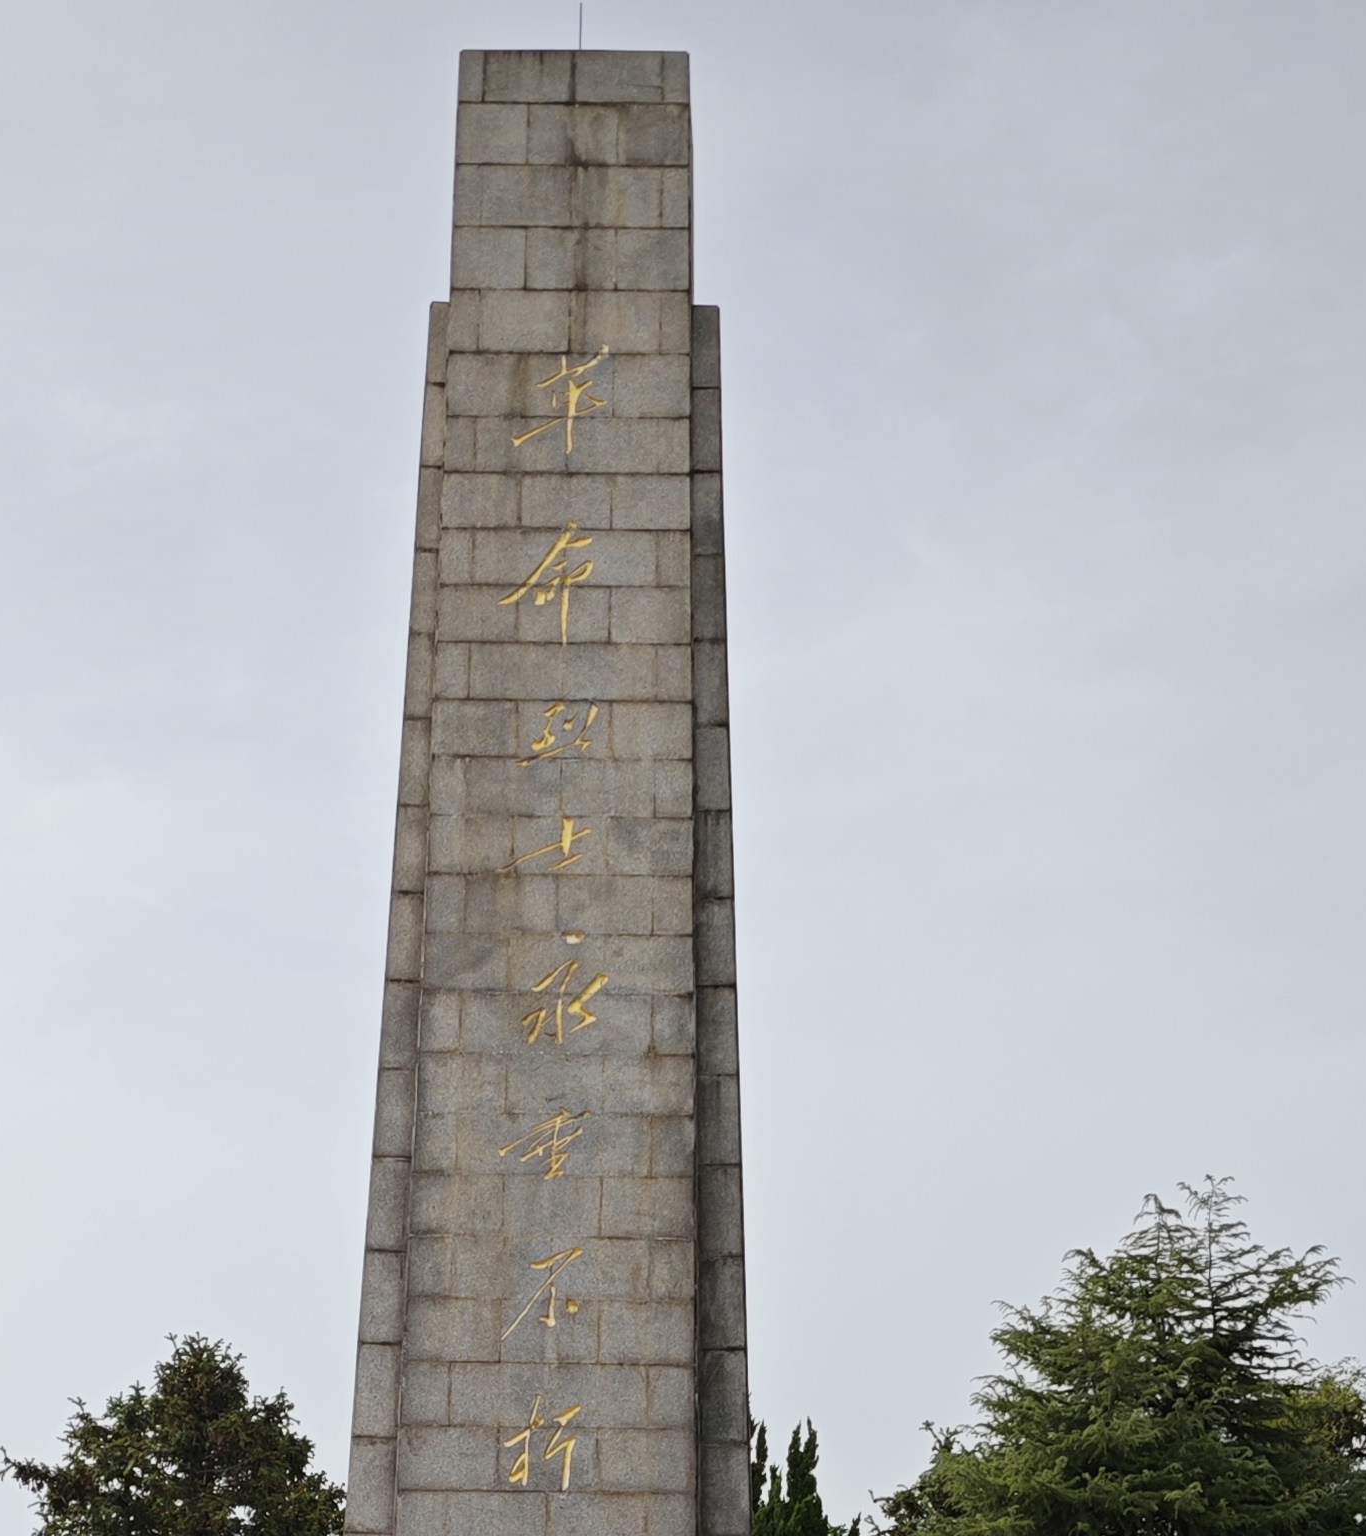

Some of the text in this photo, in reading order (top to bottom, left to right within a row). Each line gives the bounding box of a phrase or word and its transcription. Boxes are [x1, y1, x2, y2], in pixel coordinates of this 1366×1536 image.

[497, 344, 609, 1490] 革命烈士永垂不朽
